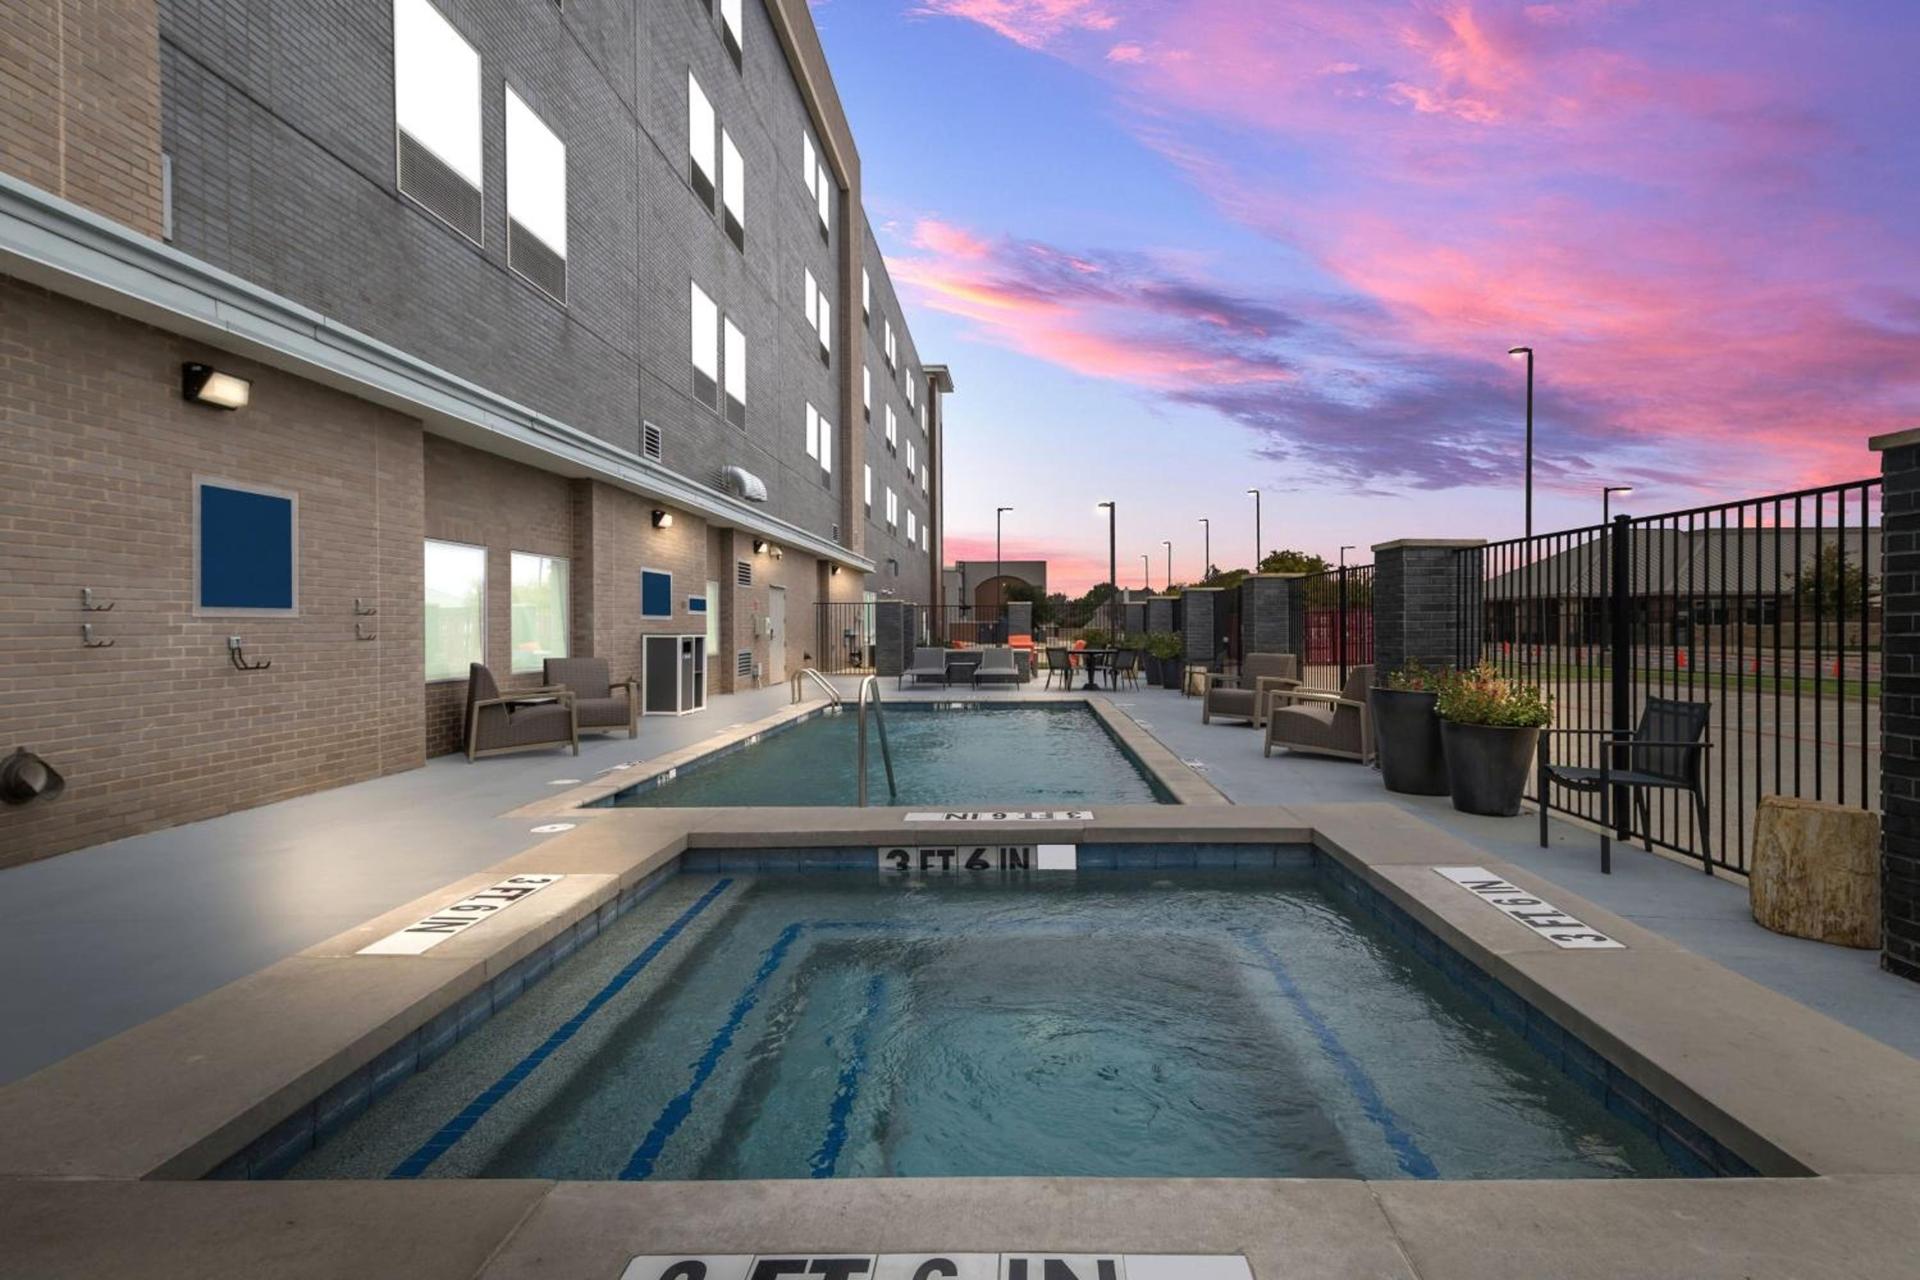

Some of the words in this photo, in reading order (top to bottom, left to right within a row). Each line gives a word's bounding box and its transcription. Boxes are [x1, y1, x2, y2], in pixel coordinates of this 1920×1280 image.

[920, 849, 956, 871] FT
[964, 848, 991, 871] 6
[1000, 847, 1030, 871] IN
[508, 877, 551, 885] 3
[1459, 879, 1522, 894] IN
[468, 886, 531, 902] FT
[449, 904, 499, 912] 6
[1492, 898, 1542, 906] 6
[403, 916, 479, 934] IN
[1510, 909, 1587, 928] FT
[1551, 933, 1607, 943] 3
